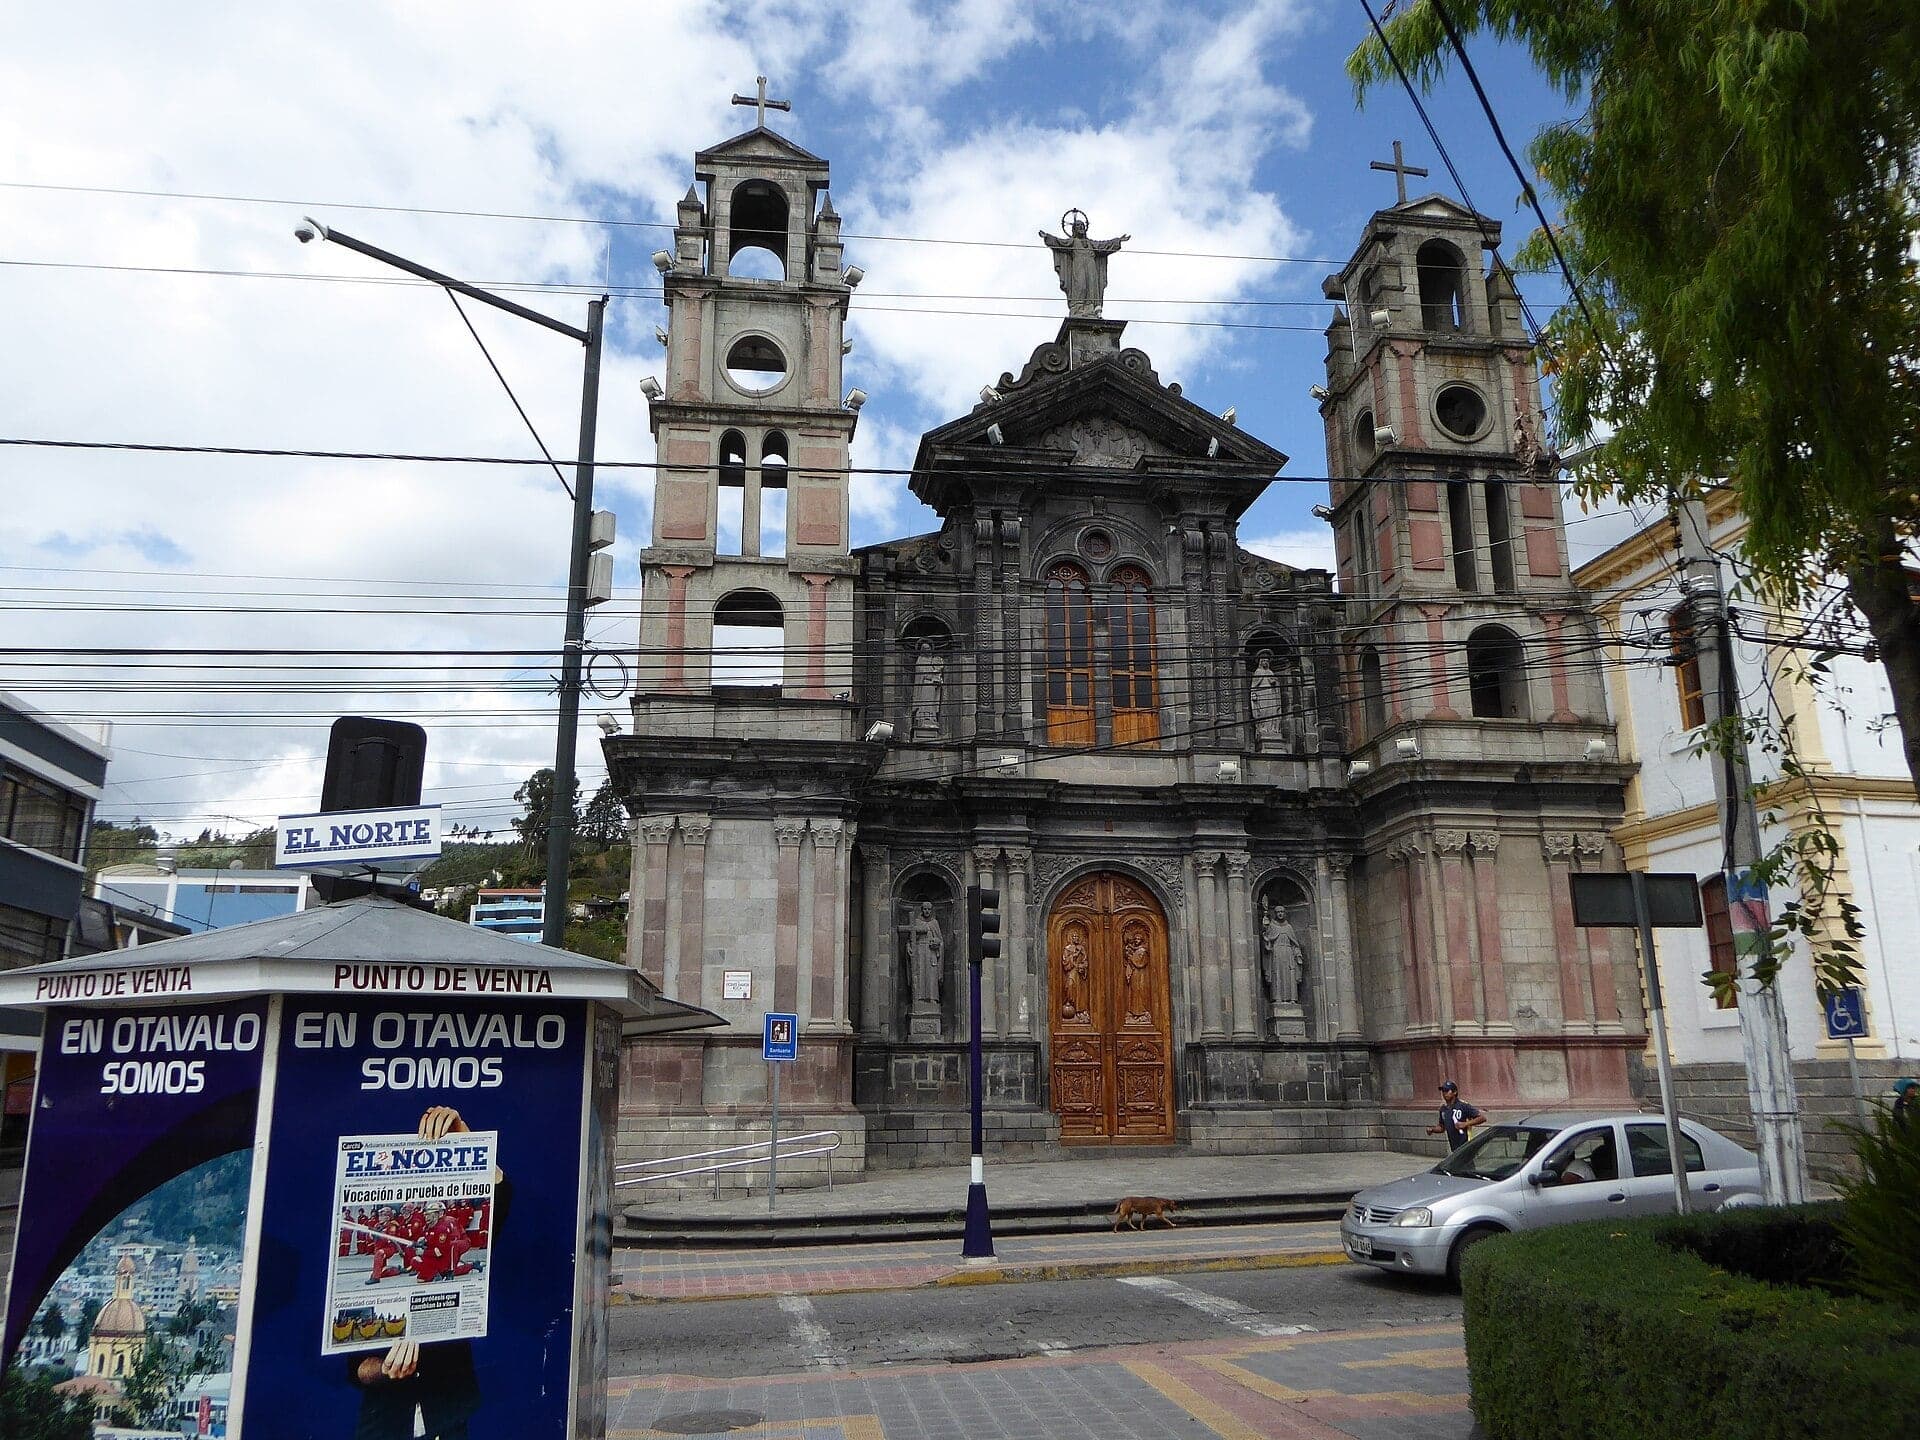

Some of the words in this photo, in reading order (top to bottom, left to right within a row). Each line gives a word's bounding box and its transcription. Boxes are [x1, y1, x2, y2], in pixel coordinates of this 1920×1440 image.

[285, 828, 320, 849] EL
[330, 819, 430, 846] NORTE
[36, 974, 97, 1000] PUNTO
[101, 972, 127, 996] DE
[132, 967, 192, 993] VENTA
[334, 964, 425, 990] PUNTO
[433, 967, 467, 992] DE
[474, 968, 554, 993] VENTA
[60, 1018, 104, 1054] EN
[112, 1013, 261, 1053] OTAVALO
[294, 1012, 358, 1049] EN
[372, 1012, 566, 1050] OTAVALO
[100, 1060, 206, 1095] SOMOS
[361, 1056, 504, 1090] SOMOS
[346, 1151, 383, 1172] EL
[391, 1146, 488, 1170] NORTE
[343, 1186, 394, 1203] Vocación
[396, 1188, 403, 1200] a
[405, 1184, 444, 1202] prueba
[446, 1183, 459, 1197] de
[462, 1182, 491, 1196] fuego
